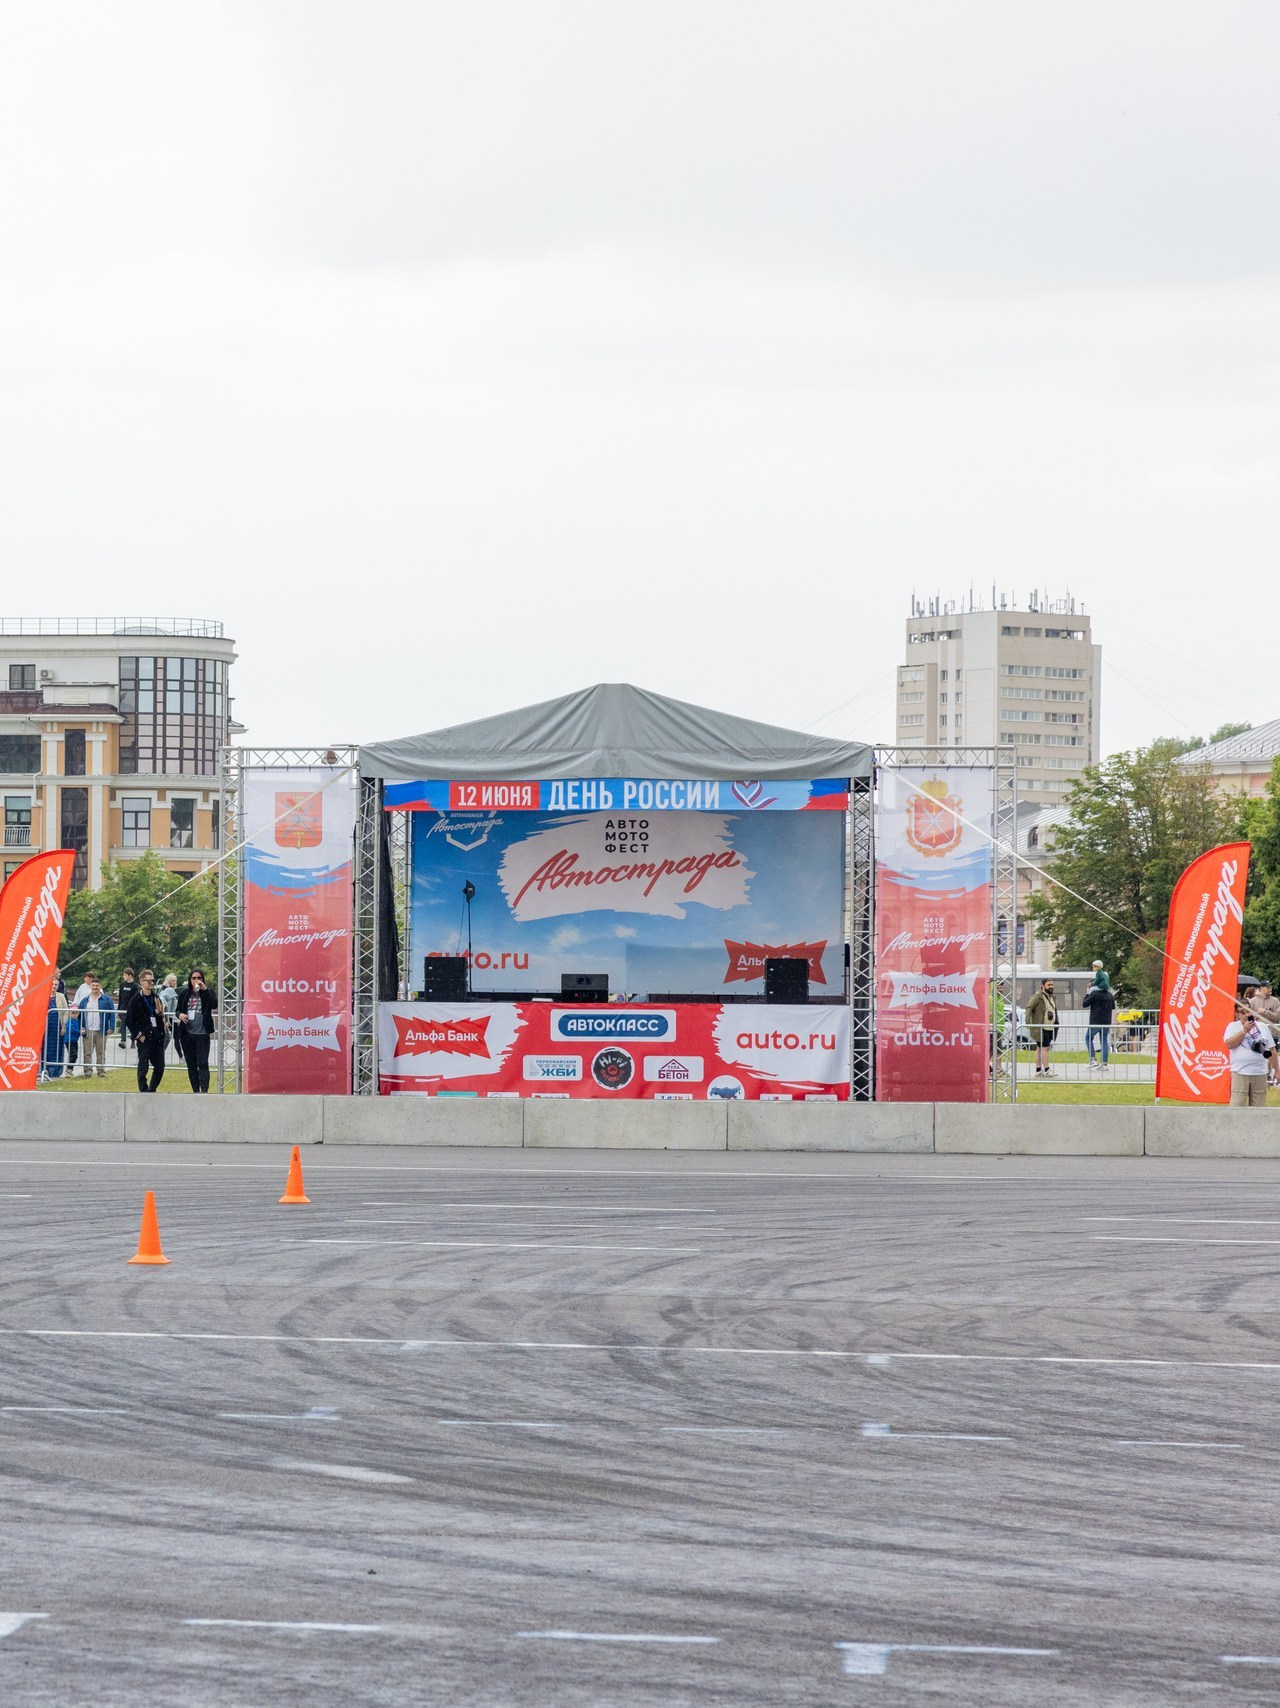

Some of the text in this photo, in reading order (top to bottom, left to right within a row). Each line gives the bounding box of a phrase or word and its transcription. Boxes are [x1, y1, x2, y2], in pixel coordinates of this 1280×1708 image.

[458, 786, 532, 806] 12 ИЮНЯ
[548, 781, 720, 811] ДЕНЬ РОССИИ
[426, 818, 504, 838] Автострада
[605, 819, 649, 829] АВТО
[605, 831, 649, 841] МОТО
[605, 843, 649, 853] ФЕСТ
[512, 849, 741, 907] Автострада
[5, 896, 33, 962] АВТОМОБИЛЬНЫЙ
[248, 928, 348, 955] Автострада
[881, 931, 987, 958] Автострада
[1169, 893, 1211, 1006] ОТКРЫТЫЙ АВТОМОБИЛЬНЫЙ
[427, 949, 529, 970] to.ru
[261, 977, 336, 993] auto.ru
[1163, 859, 1244, 1095] Автострада
[1176, 963, 1197, 1009] ФЕСТИВАЛЬ
[900, 983, 967, 995] Альфа Банк
[267, 1026, 330, 1038] Альфа Банк
[567, 1019, 659, 1032] АВТОКЛАСС
[405, 1029, 479, 1043] Альфа Банк
[736, 1030, 836, 1050] auto.ru
[894, 1030, 973, 1046] auto.ru
[541, 1068, 577, 1077] ЖБИ
